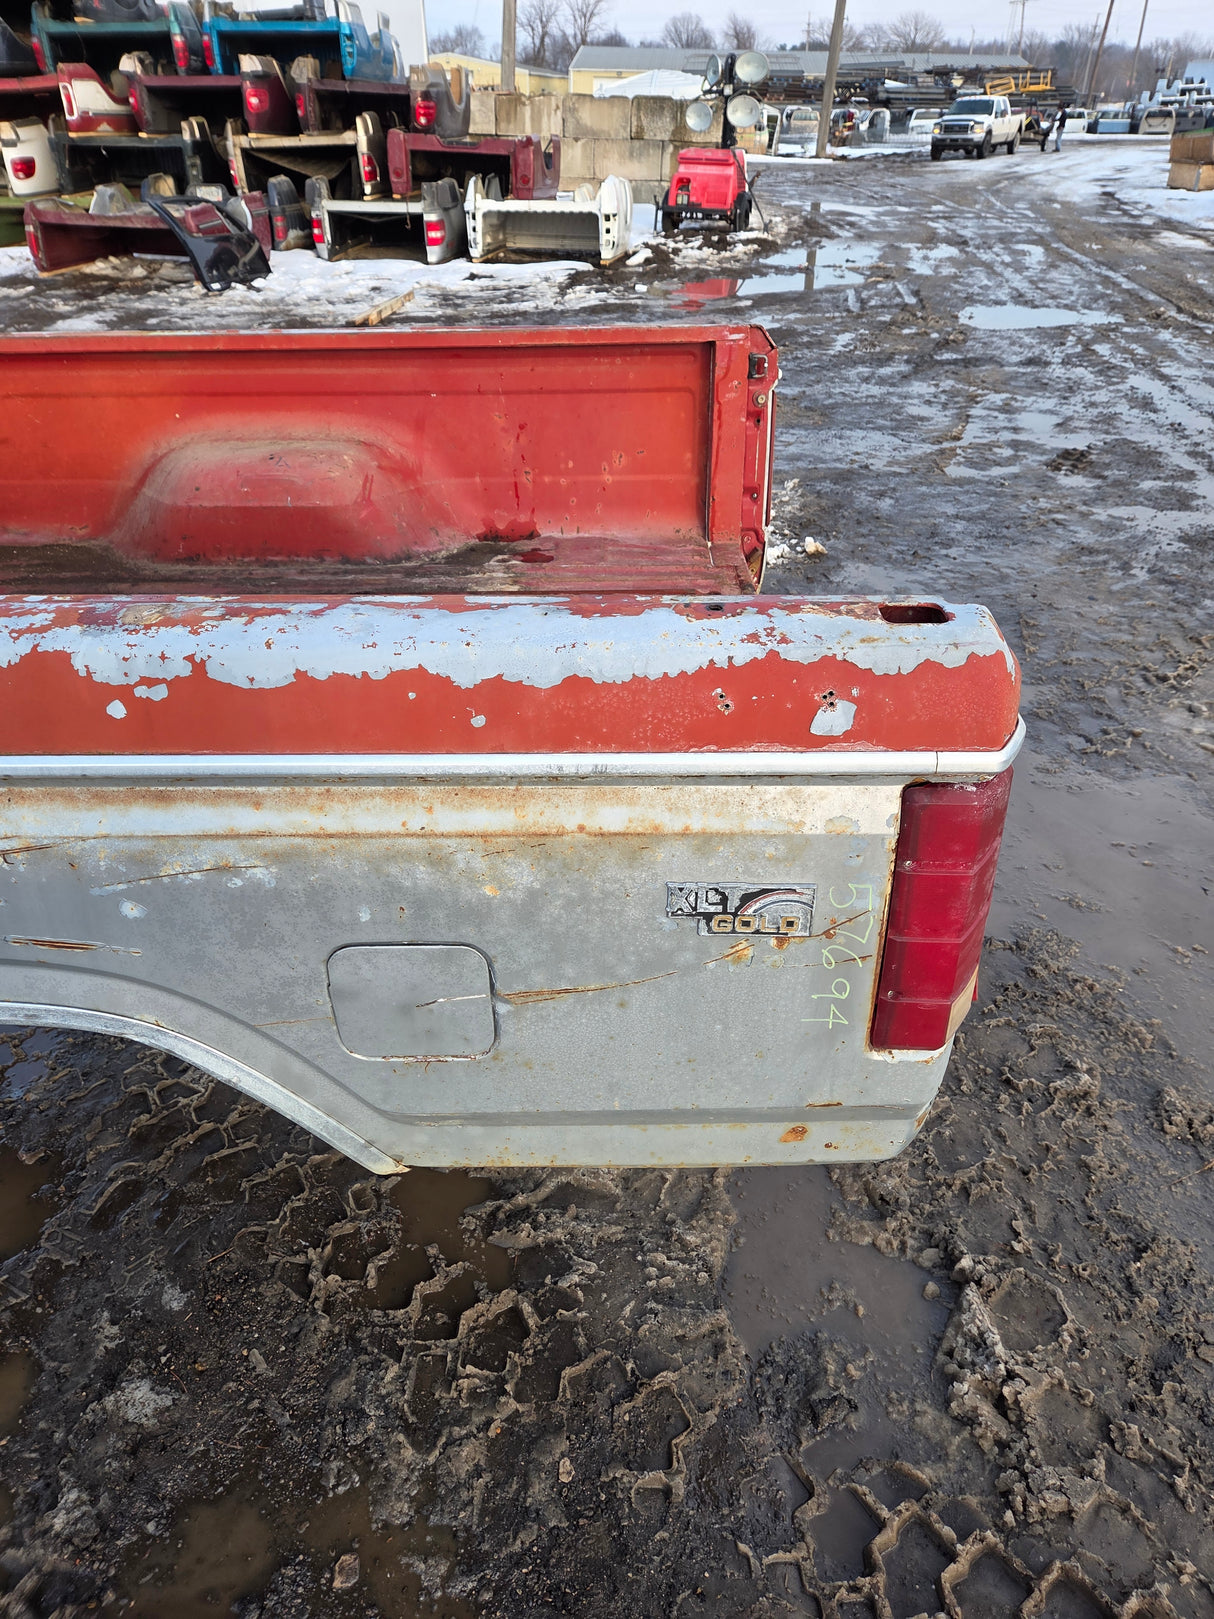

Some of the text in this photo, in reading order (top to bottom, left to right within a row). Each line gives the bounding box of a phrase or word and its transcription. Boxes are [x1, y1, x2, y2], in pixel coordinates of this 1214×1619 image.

[668, 886, 743, 913] XLT
[711, 914, 800, 932] GOLD
[800, 883, 873, 1029] 57694
